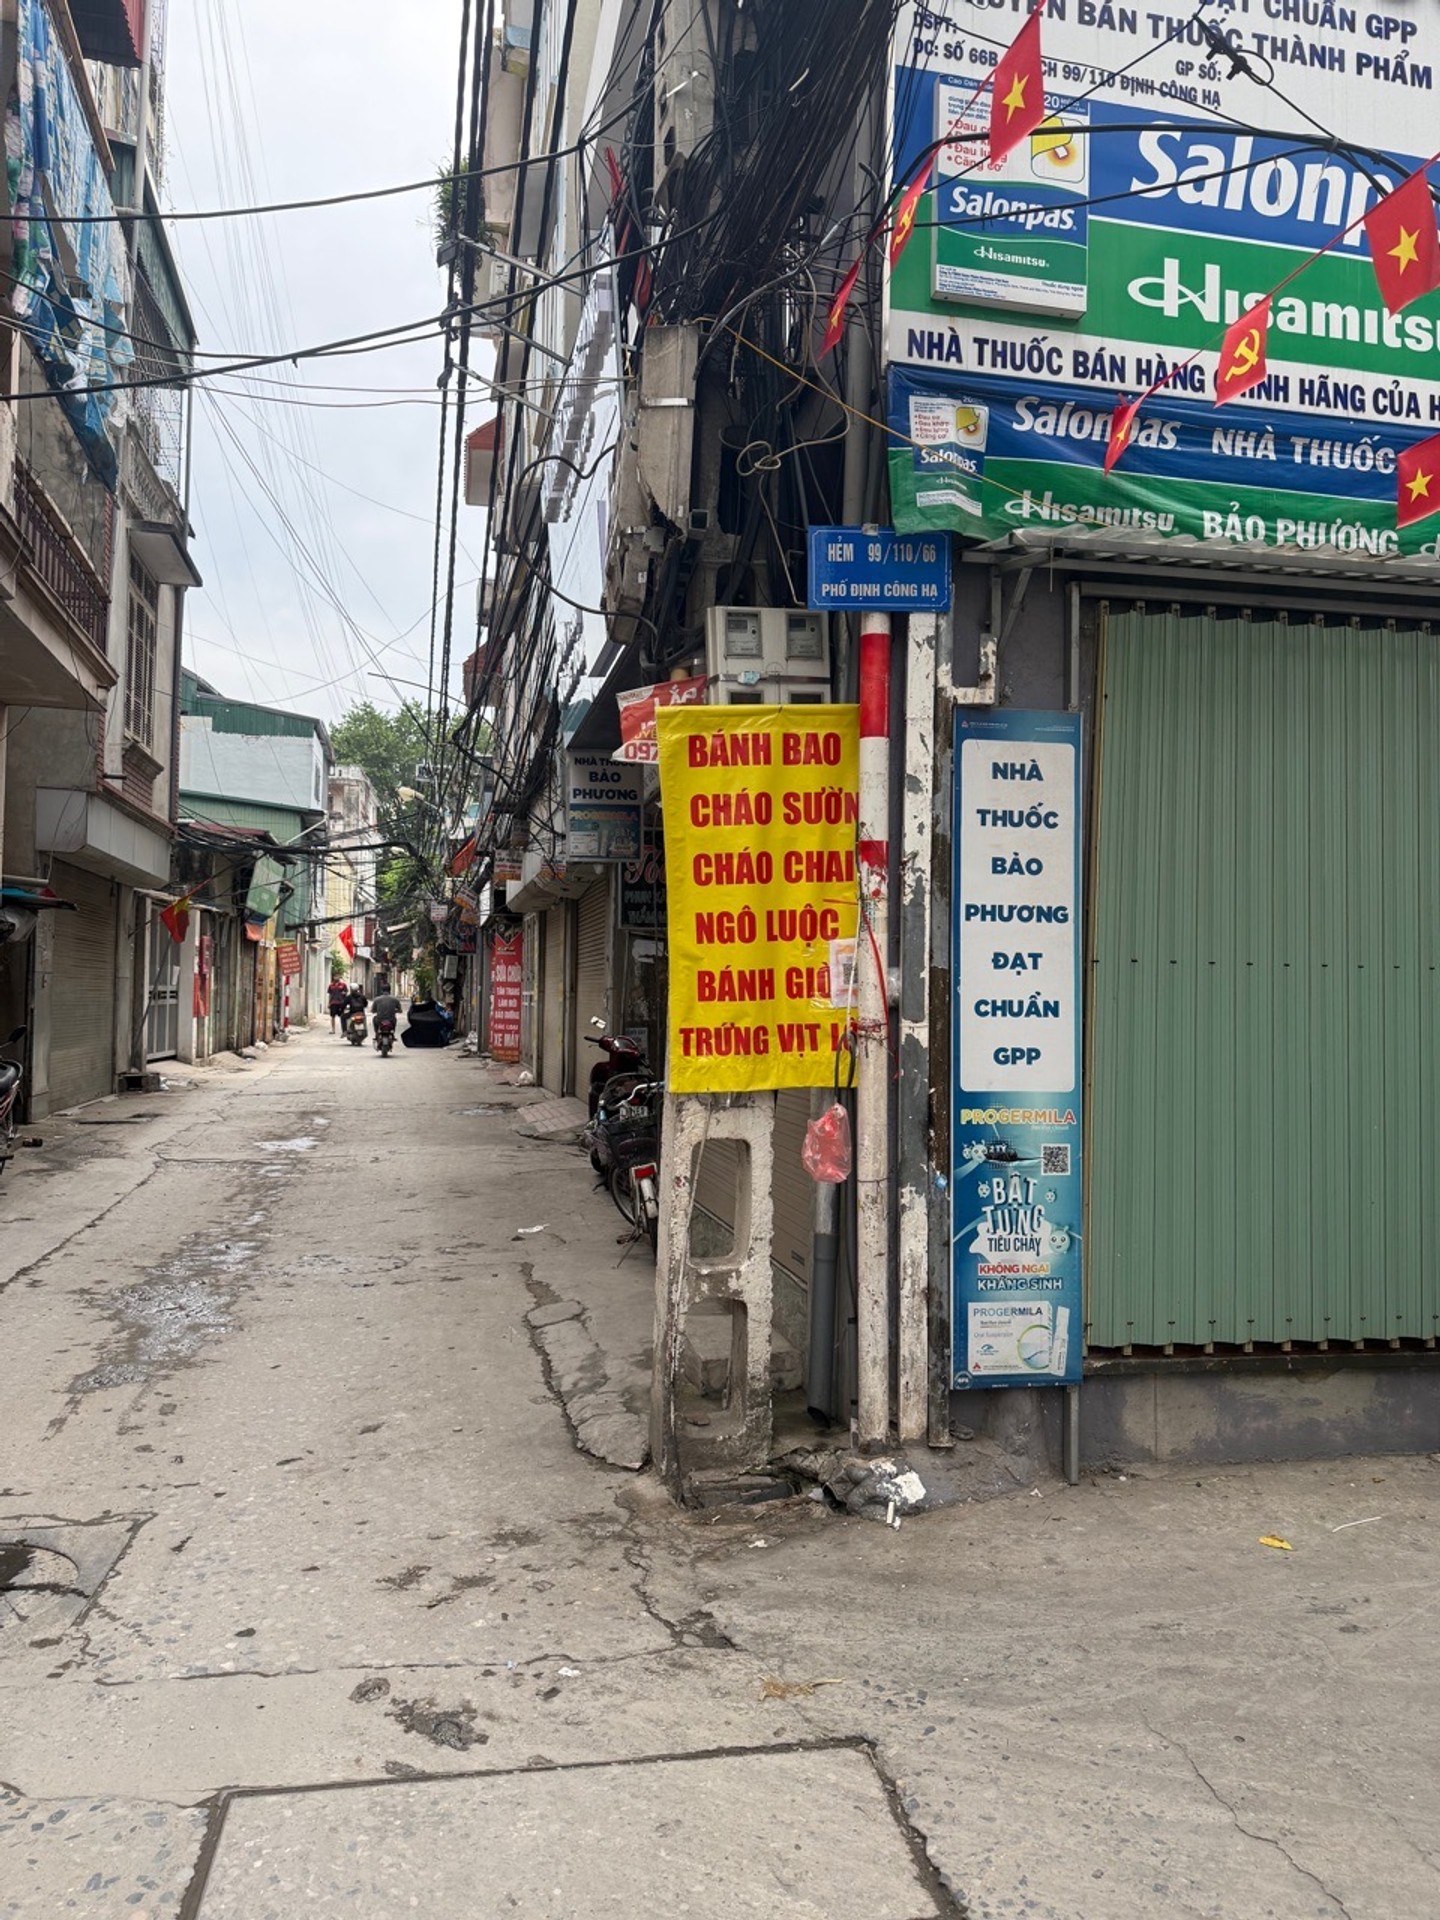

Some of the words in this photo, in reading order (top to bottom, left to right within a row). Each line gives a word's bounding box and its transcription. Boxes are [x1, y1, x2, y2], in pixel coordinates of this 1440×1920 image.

[1366, 13, 1417, 44] GPP
[943, 38, 964, 61] SỐ
[969, 47, 999, 67] 66B
[1078, 0, 1136, 35] BÁN
[1251, 33, 1345, 73] THÀNH
[1356, 50, 1432, 90] PHẨM
[1175, 60, 1194, 77] GP
[1198, 60, 1222, 82] SỐ:
[1062, 65, 1116, 88] 99/110
[1120, 75, 1155, 97] ĐỊNH
[1159, 80, 1198, 103] CÔNG
[1202, 88, 1221, 110] HẠ
[949, 185, 1075, 231] Salonpas
[1127, 257, 1440, 354] Hisamits
[908, 326, 963, 364] NHÀ
[973, 336, 1063, 376] THUỐC
[1072, 347, 1127, 384] BÁN
[1136, 353, 1206, 394] HÀNG
[1299, 374, 1366, 415] HÃNG
[1372, 379, 1422, 420] CỦA
[1211, 424, 1277, 461] NHÀ
[1289, 434, 1398, 475] THUỐC
[1004, 489, 1176, 532] Hisamitsu
[1203, 501, 1266, 543] BẢO
[1276, 517, 1399, 557] PHƯƠNG
[867, 542, 937, 565] 99/110/66
[821, 578, 847, 597] PHỐ
[850, 582, 880, 601] ĐỊNH
[884, 580, 918, 597] CÔNG
[921, 583, 938, 601] HẠ
[574, 756, 597, 766] NHÀ
[688, 729, 772, 768] BÁNH
[782, 731, 841, 767] BAO
[992, 759, 1044, 781] NHÀ
[690, 788, 772, 828] CHÁO
[782, 786, 860, 826] SƯỜN
[976, 802, 1059, 829] THUỐC
[693, 846, 773, 887] CHÁO
[784, 850, 855, 884] CHAI
[695, 904, 757, 945] NGÔ
[766, 903, 840, 948] LUỘC
[965, 903, 1069, 924] PHƯƠNG
[991, 952, 1043, 976] ĐẠT
[697, 965, 775, 1002] BÁNH
[974, 991, 1060, 1019] CHUẨN
[679, 1022, 769, 1057] TRỨNG
[776, 1023, 821, 1058] VỊT
[993, 1047, 1041, 1066] GPP
[960, 1108, 1077, 1125] PROGERMILA
[991, 1171, 1038, 1207] BẬT
[987, 1235, 1012, 1252] TIÊU
[1015, 1234, 1042, 1257] CHẢY
[979, 1262, 1020, 1274] KHÔNG
[1030, 1279, 1062, 1290] SINH
[973, 1306, 1043, 1317] PROGERMILA
